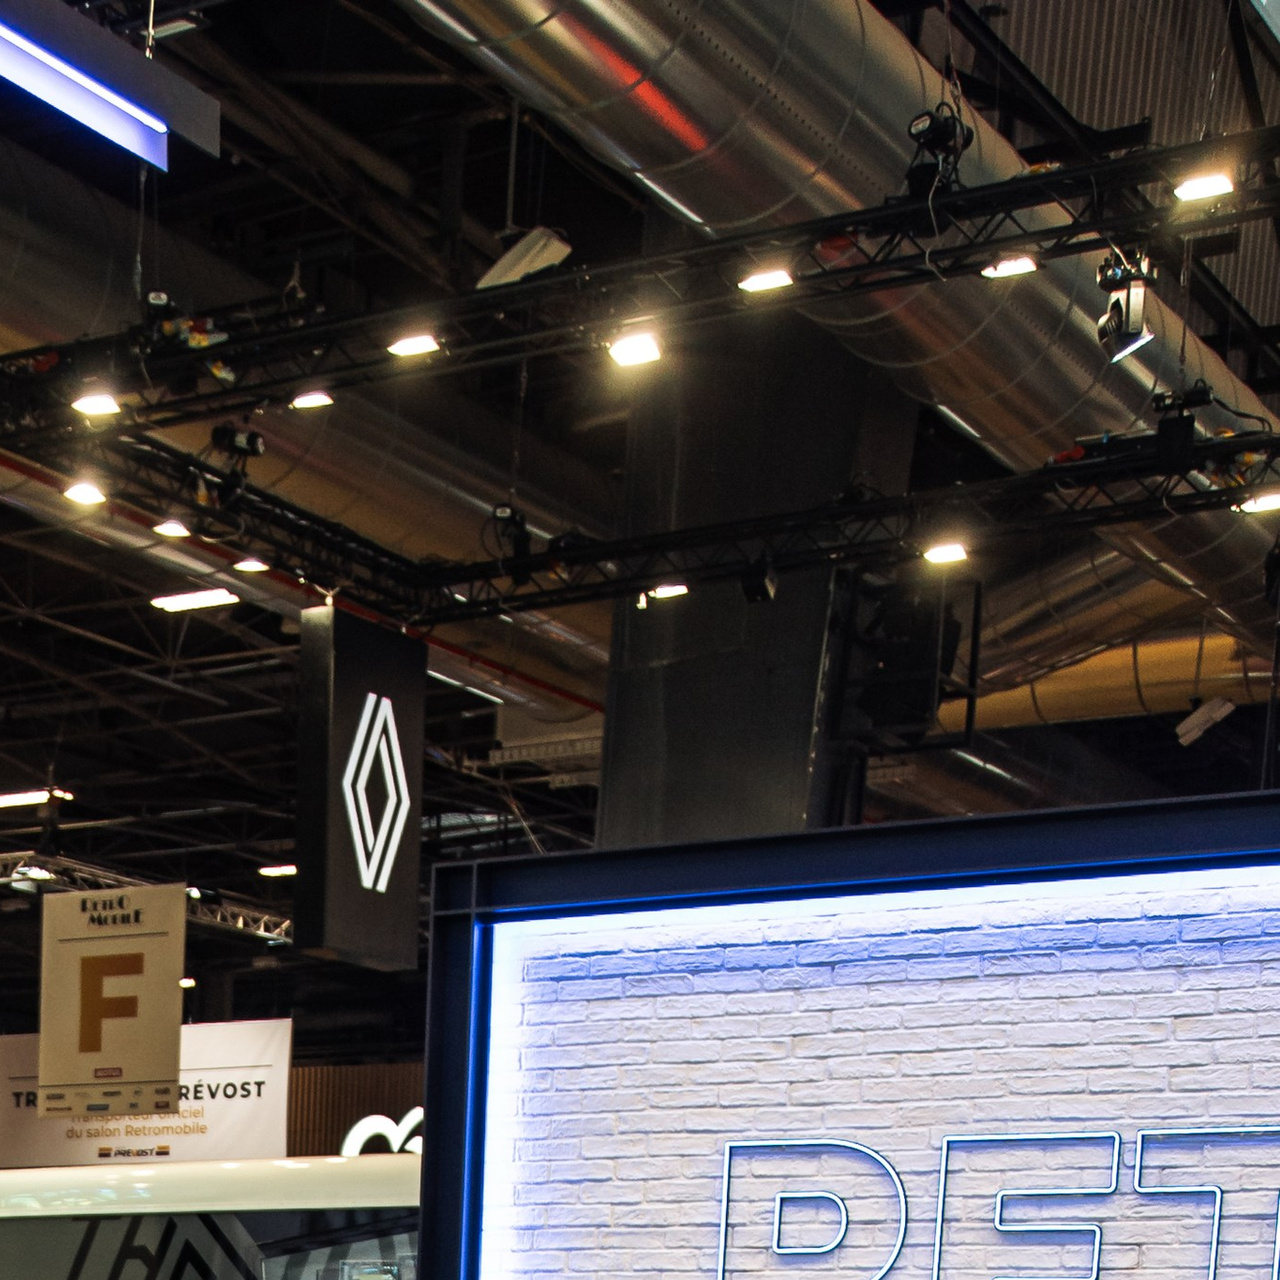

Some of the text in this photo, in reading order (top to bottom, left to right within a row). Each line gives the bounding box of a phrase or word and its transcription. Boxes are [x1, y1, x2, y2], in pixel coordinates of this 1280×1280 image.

[79, 953, 145, 1053] F
[177, 1080, 267, 1101] RÉVOST
[66, 1122, 208, 1139] du salon Retromobile
